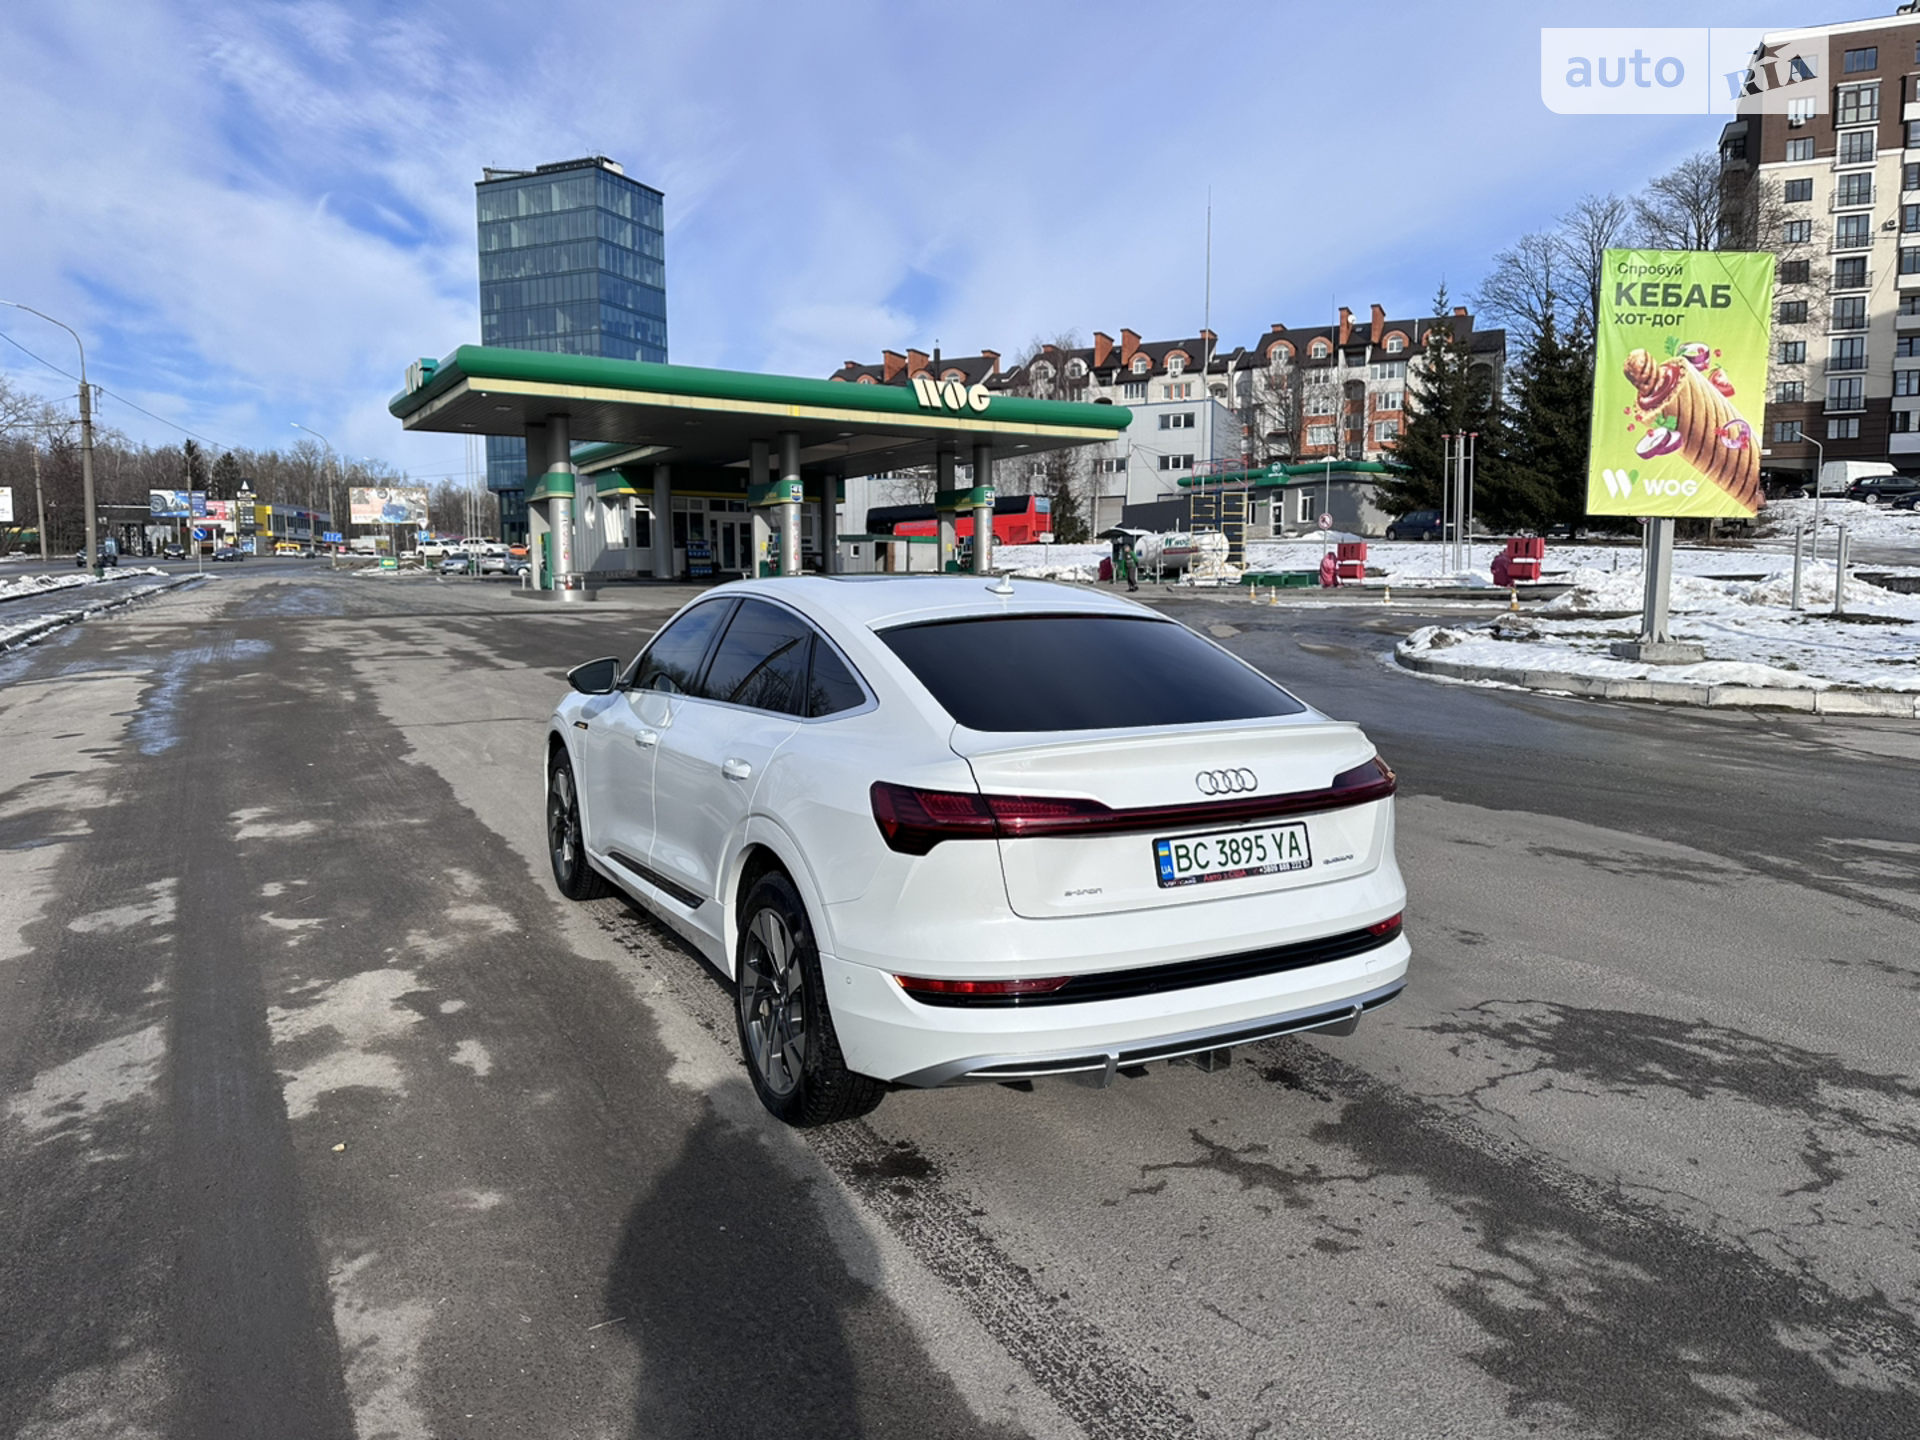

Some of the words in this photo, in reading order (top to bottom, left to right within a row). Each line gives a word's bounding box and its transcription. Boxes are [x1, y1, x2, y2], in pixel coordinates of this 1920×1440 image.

[1617, 262, 1683, 277] Спробуй
[1614, 282, 1732, 309] КЕБАБ
[912, 378, 991, 411] WOG
[1643, 479, 1698, 497] WOG
[1174, 842, 1210, 873] BC
[1216, 834, 1268, 867] 3895
[1271, 830, 1302, 860] YA
[1161, 865, 1173, 875] UA
